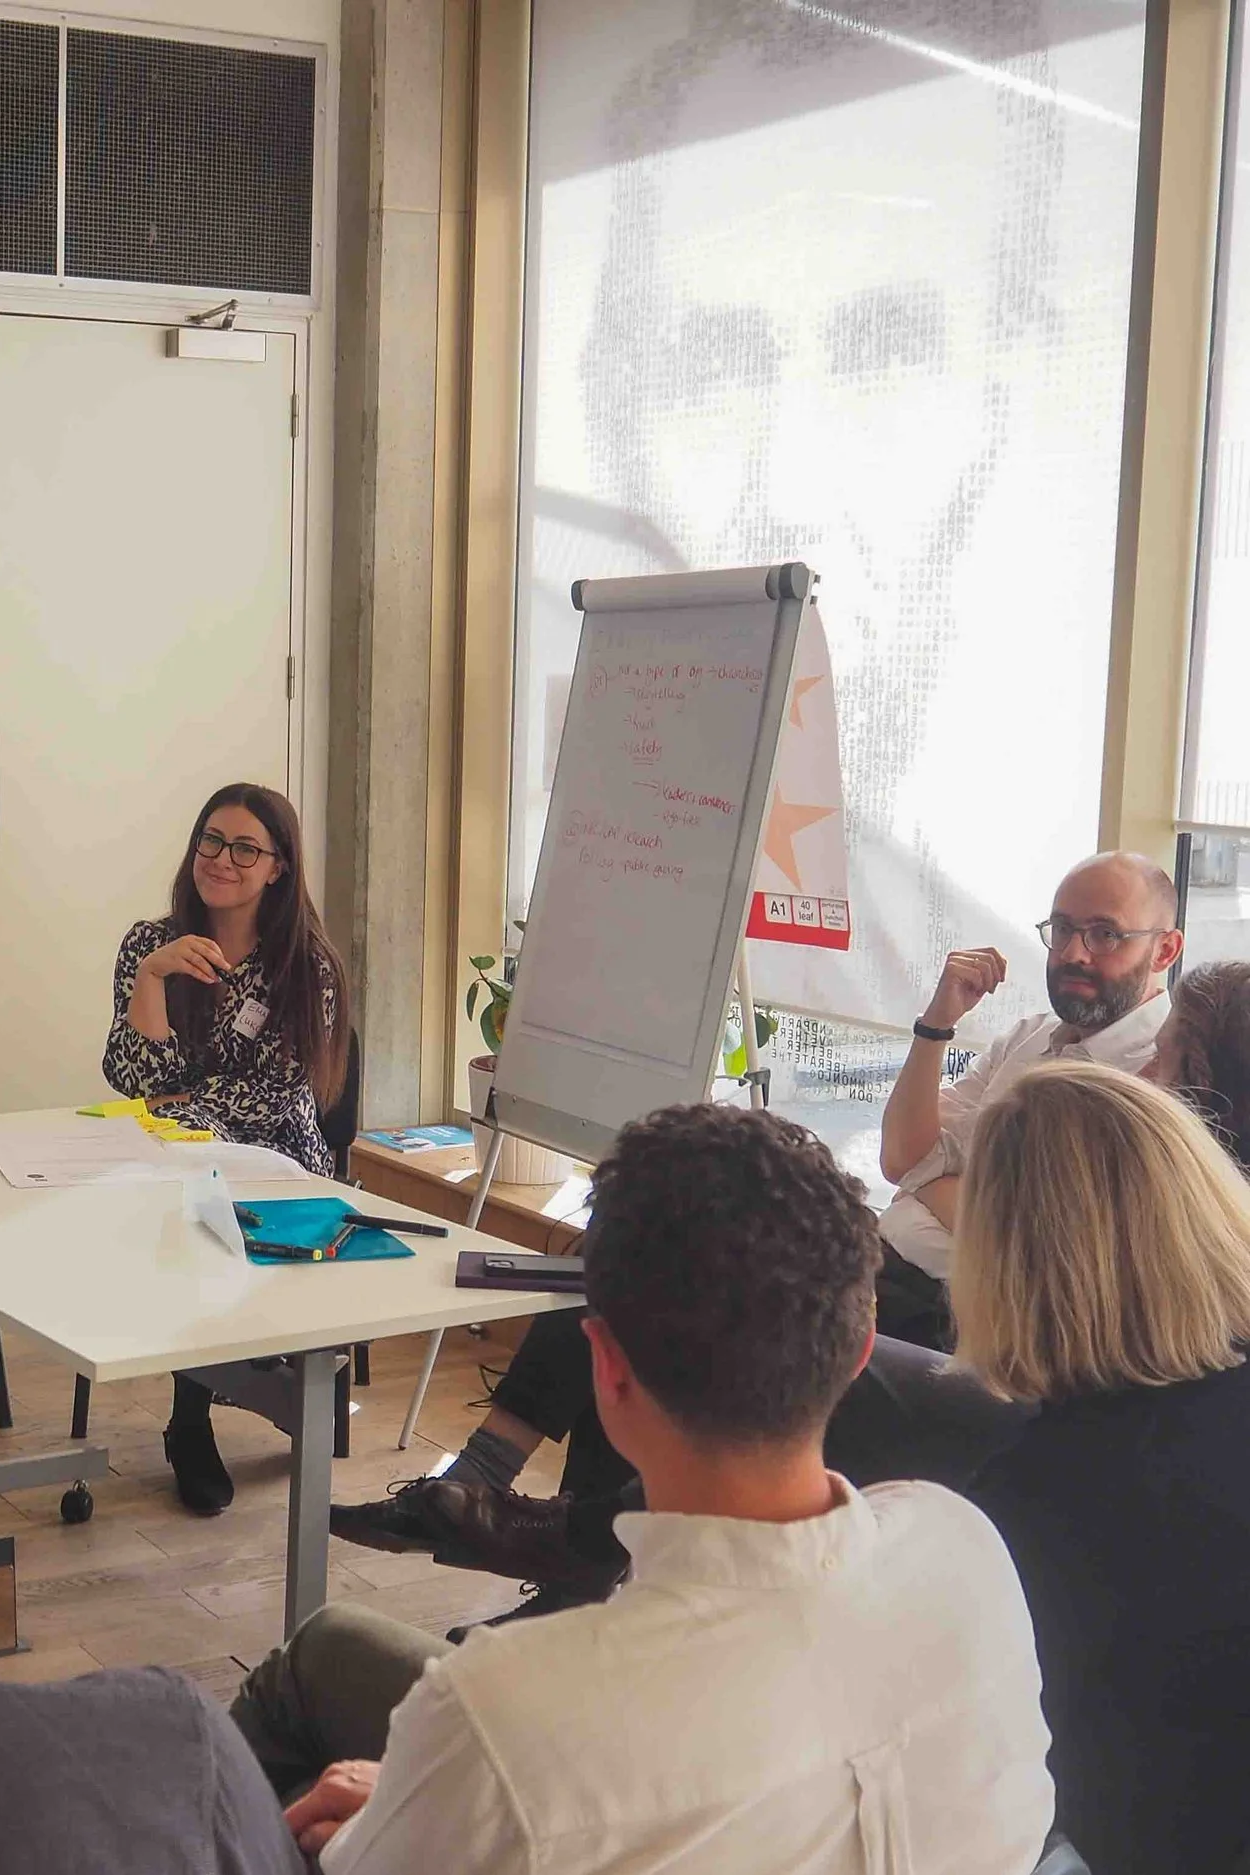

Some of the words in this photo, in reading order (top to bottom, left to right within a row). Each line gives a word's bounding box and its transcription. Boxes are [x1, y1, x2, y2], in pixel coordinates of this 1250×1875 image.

[770, 900, 786, 916] A1
[800, 900, 811, 910] 40
[799, 911, 814, 922] leaf
